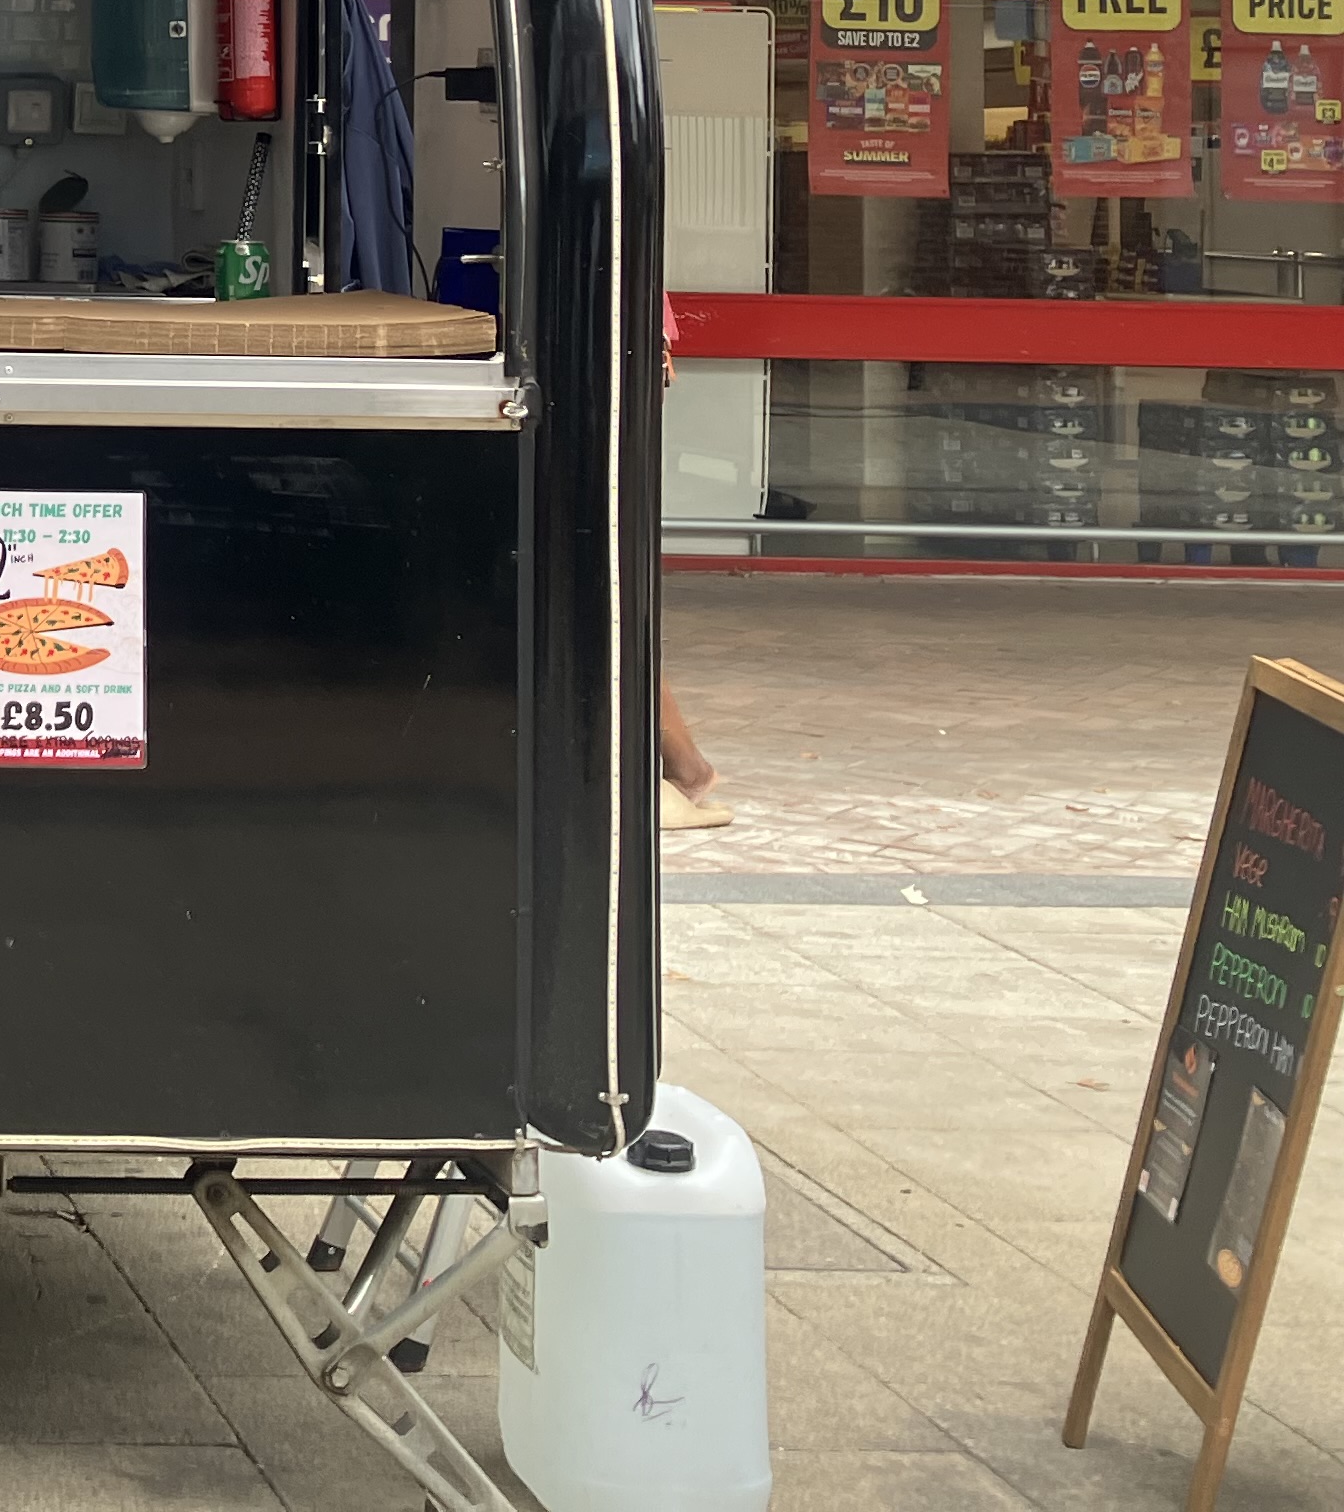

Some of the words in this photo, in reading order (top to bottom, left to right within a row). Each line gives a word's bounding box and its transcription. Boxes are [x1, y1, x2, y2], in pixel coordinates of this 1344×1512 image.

[838, 30, 868, 46] SAVE
[869, 32, 885, 47] UP
[886, 33, 902, 47] TO
[904, 33, 920, 47] £2
[843, 150, 909, 163] SUMMER
[29, 503, 66, 517] TIME
[73, 503, 123, 518] OFFER
[58, 529, 91, 544] 2:30
[11, 553, 34, 564] INCH
[8, 684, 36, 693] PIZZA
[40, 684, 61, 694] AND
[65, 684, 72, 694] A
[76, 684, 100, 694] SOFT
[104, 684, 133, 694] DRINK
[1, 701, 94, 731] £8.50
[23, 748, 40, 758] ARE
[42, 748, 54, 758] AN
